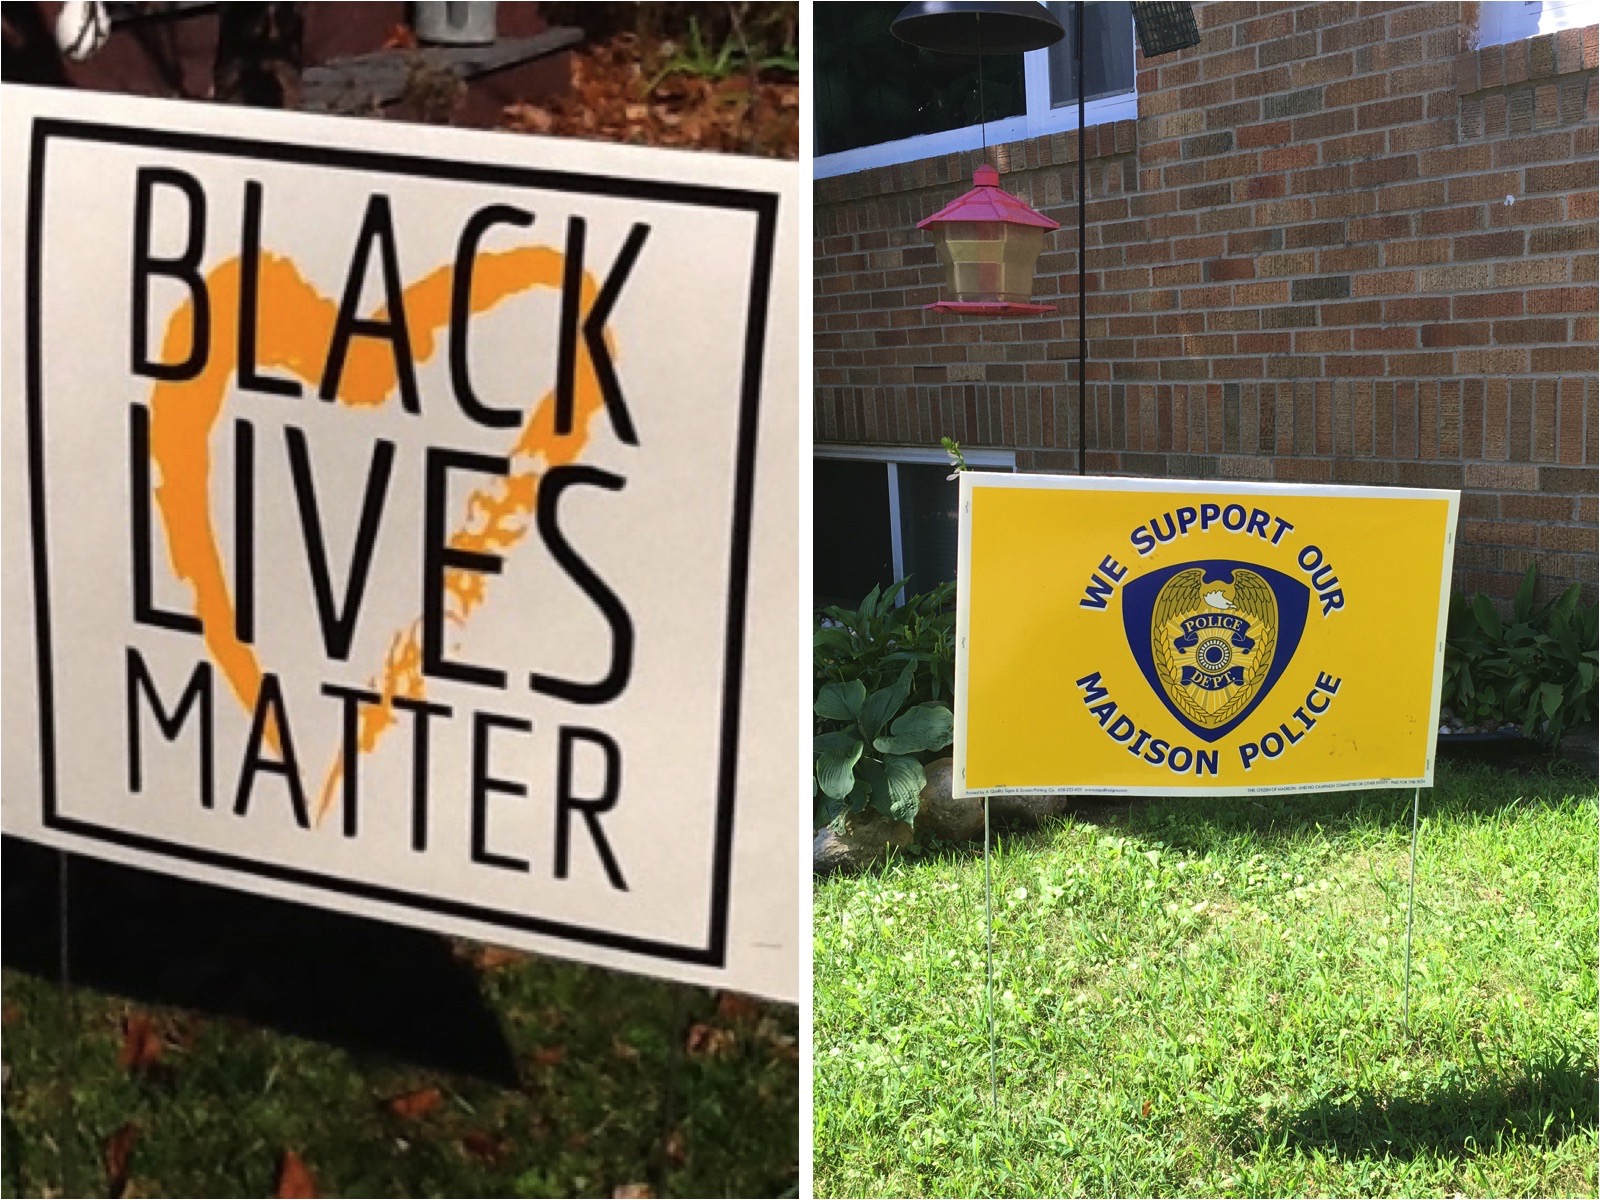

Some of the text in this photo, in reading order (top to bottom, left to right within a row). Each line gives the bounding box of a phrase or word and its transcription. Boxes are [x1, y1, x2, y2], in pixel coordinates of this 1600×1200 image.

[130, 166, 651, 447] BLACK
[129, 401, 635, 705] LIVES
[1079, 503, 1346, 617] WE SUPPORT OUR
[1185, 615, 1243, 633] POLICE
[1190, 669, 1236, 688] DEPT.
[126, 645, 630, 894] MATTER
[1075, 670, 1343, 777] MADISON POLICE
